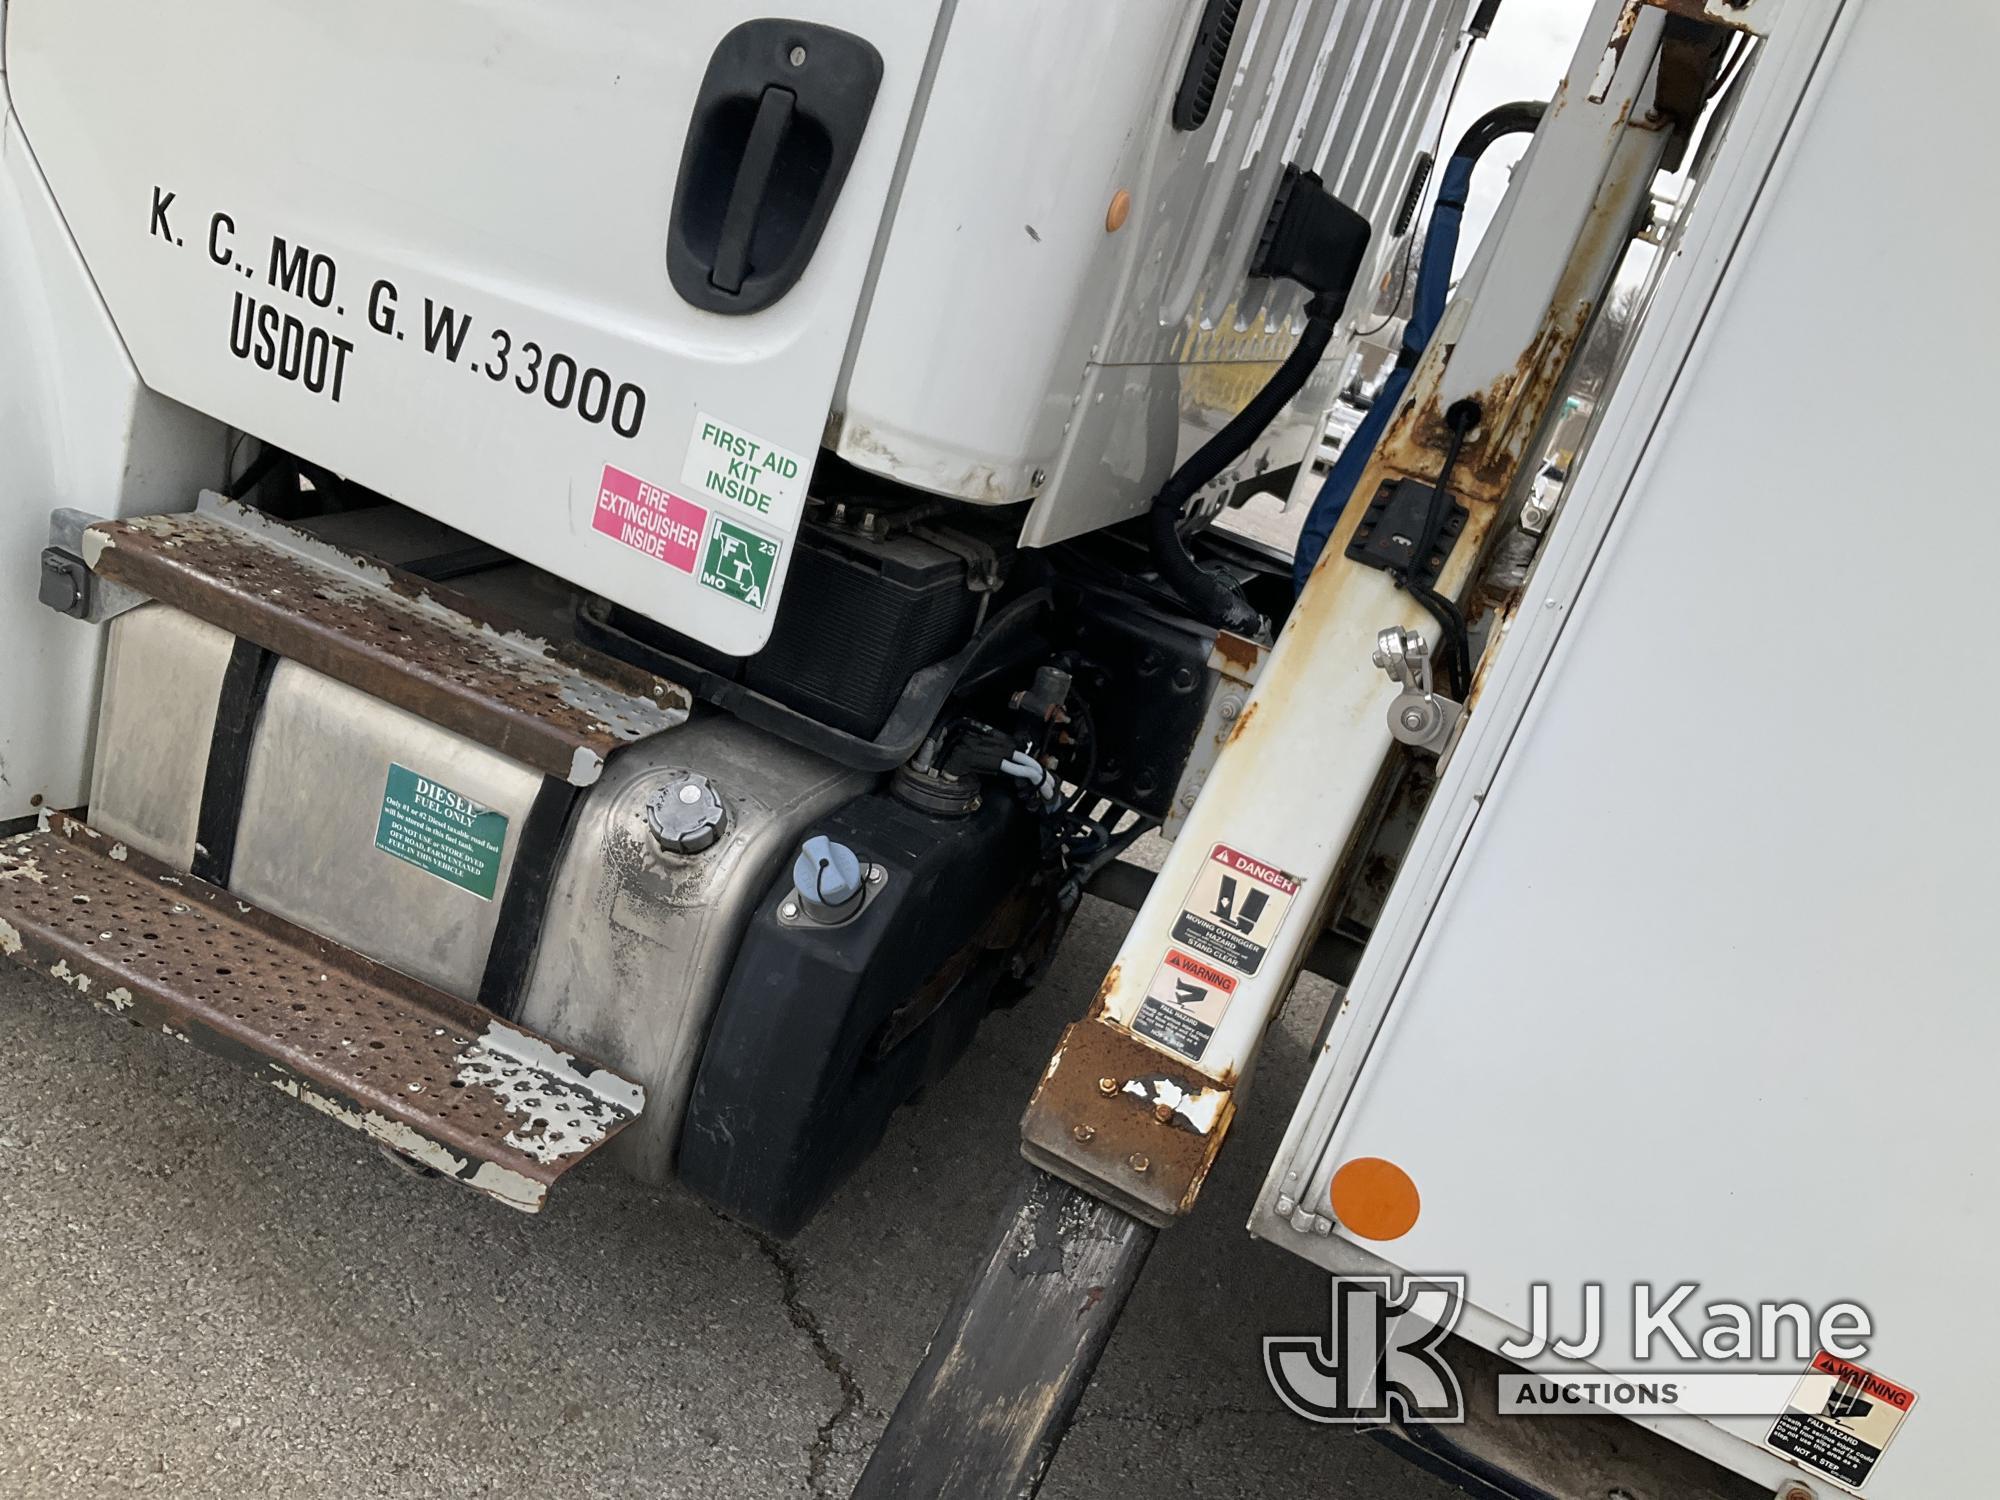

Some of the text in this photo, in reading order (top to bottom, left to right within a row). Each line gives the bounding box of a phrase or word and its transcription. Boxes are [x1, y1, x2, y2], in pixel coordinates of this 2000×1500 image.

[150, 186, 184, 247] K.
[268, 236, 345, 315] MO.
[229, 291, 354, 403] USDOT
[702, 423, 798, 479] FIRST AID
[728, 458, 762, 485] KIT
[637, 483, 670, 513] FIRE
[705, 470, 772, 514] INSIDE
[600, 488, 699, 551] EXTINGUISHER
[621, 523, 666, 559] INSIDE
[758, 541, 776, 557] 23
[702, 571, 726, 590] MO
[415, 794, 475, 827] FUEL ONLY
[416, 778, 477, 818] DIESEL
[390, 830, 404, 840] OFF
[392, 821, 402, 831] DO
[403, 826, 418, 838] NOT
[419, 833, 432, 845] USE
[389, 838, 406, 851] FUEL
[433, 858, 464, 877] VEHICLE
[1236, 858, 1294, 892] DANGER
[1186, 914, 1215, 931] MOVING
[1216, 929, 1260, 952] OUTRIGGER
[1206, 932, 1236, 949] HAZARD
[1188, 939, 1213, 953] STAND
[1214, 951, 1238, 966] CLEAR
[1182, 960, 1232, 990] WARNING
[1837, 1363, 1906, 1406] WARNING
[1777, 1425, 1786, 1433] Do
[1800, 1437, 1811, 1445] use
[1814, 1443, 1825, 1452] this
[1827, 1451, 1841, 1460] area
[1783, 1415, 1801, 1427] Death
[1812, 1430, 1835, 1444] serious
[1837, 1442, 1854, 1453] injury
[1856, 1452, 1874, 1463] could
[1800, 1429, 1815, 1440] from
[1832, 1446, 1845, 1455] and
[1807, 1418, 1858, 1446] FALL HAZARD
[1794, 1445, 1810, 1457] NOT
[1819, 1458, 1839, 1471] STEP
